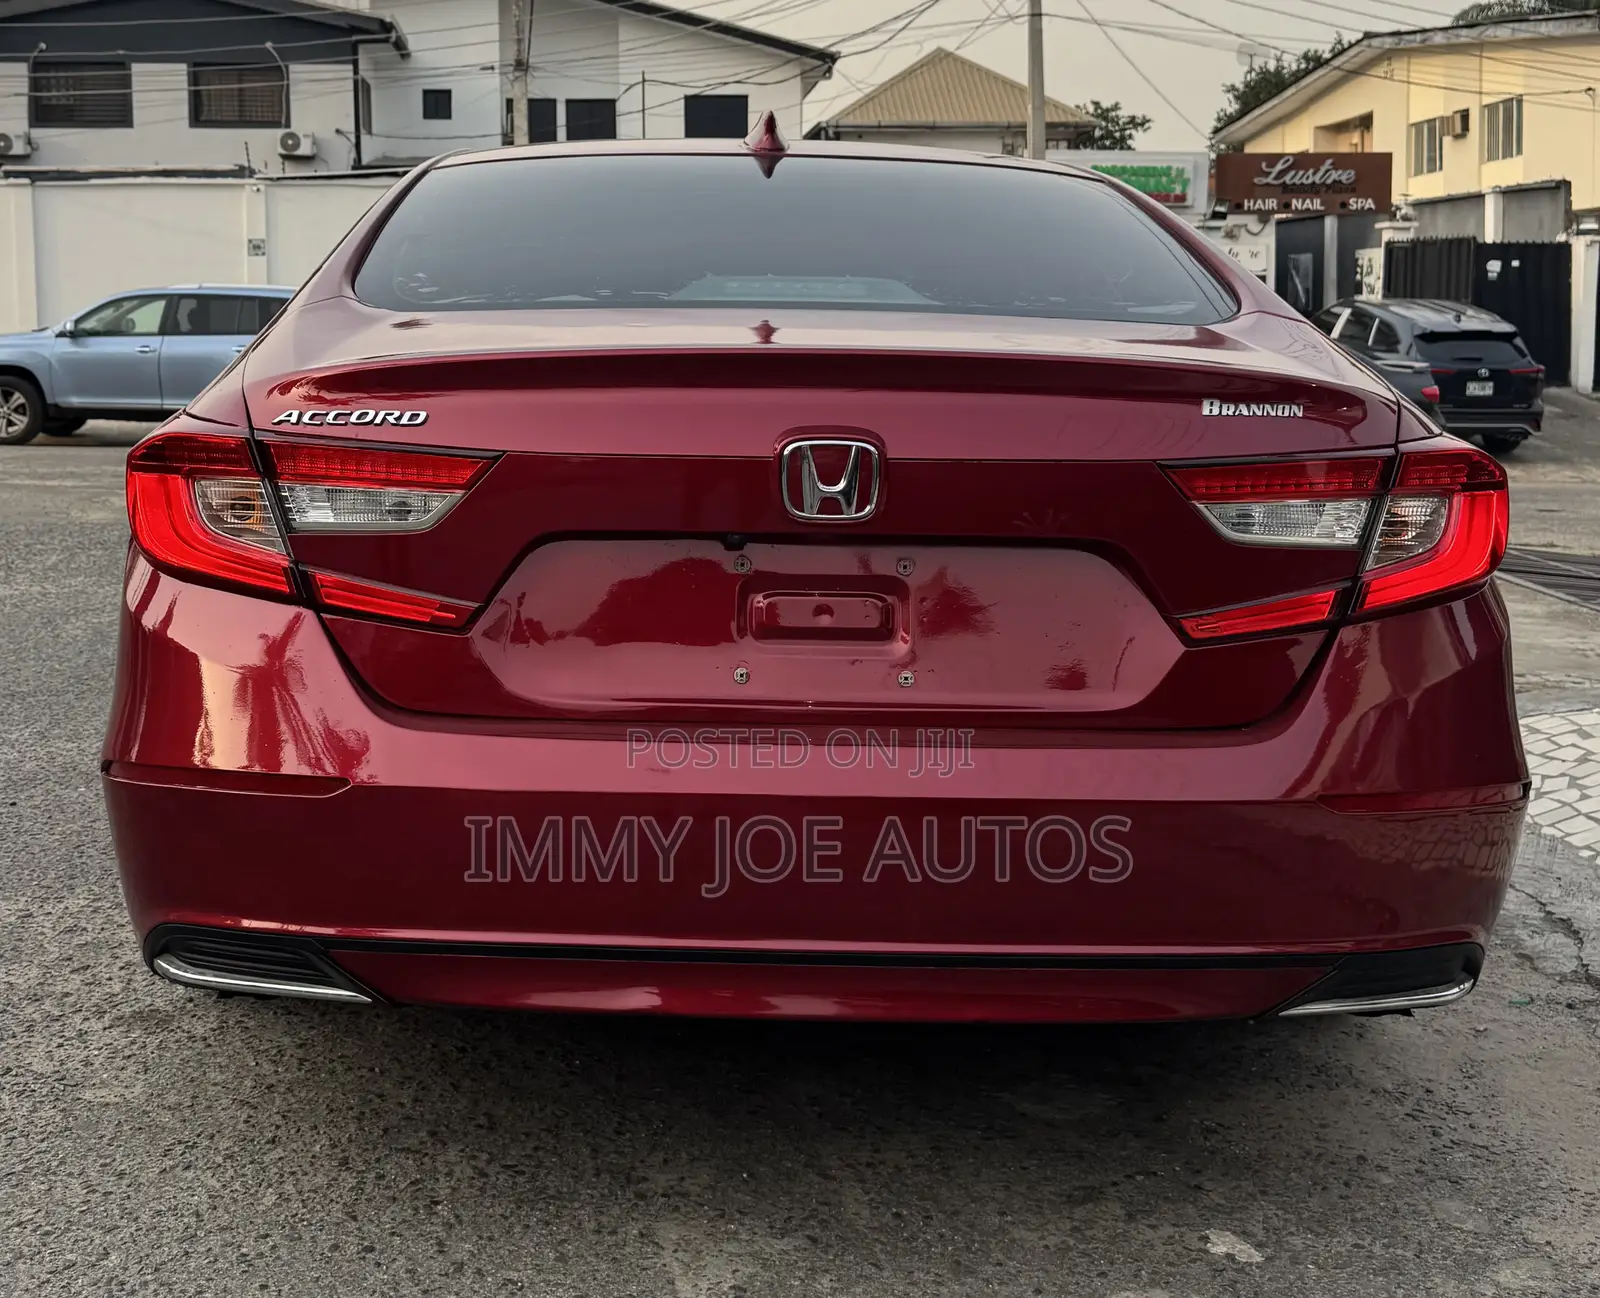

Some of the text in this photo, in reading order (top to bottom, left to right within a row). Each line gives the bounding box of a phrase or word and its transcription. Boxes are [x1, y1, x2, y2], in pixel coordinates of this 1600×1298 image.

[1253, 155, 1356, 186] Lustre
[1243, 199, 1376, 211] HAIR NAIL SPA
[1201, 398, 1304, 418] BRANNON
[271, 409, 429, 427] ACCORD
